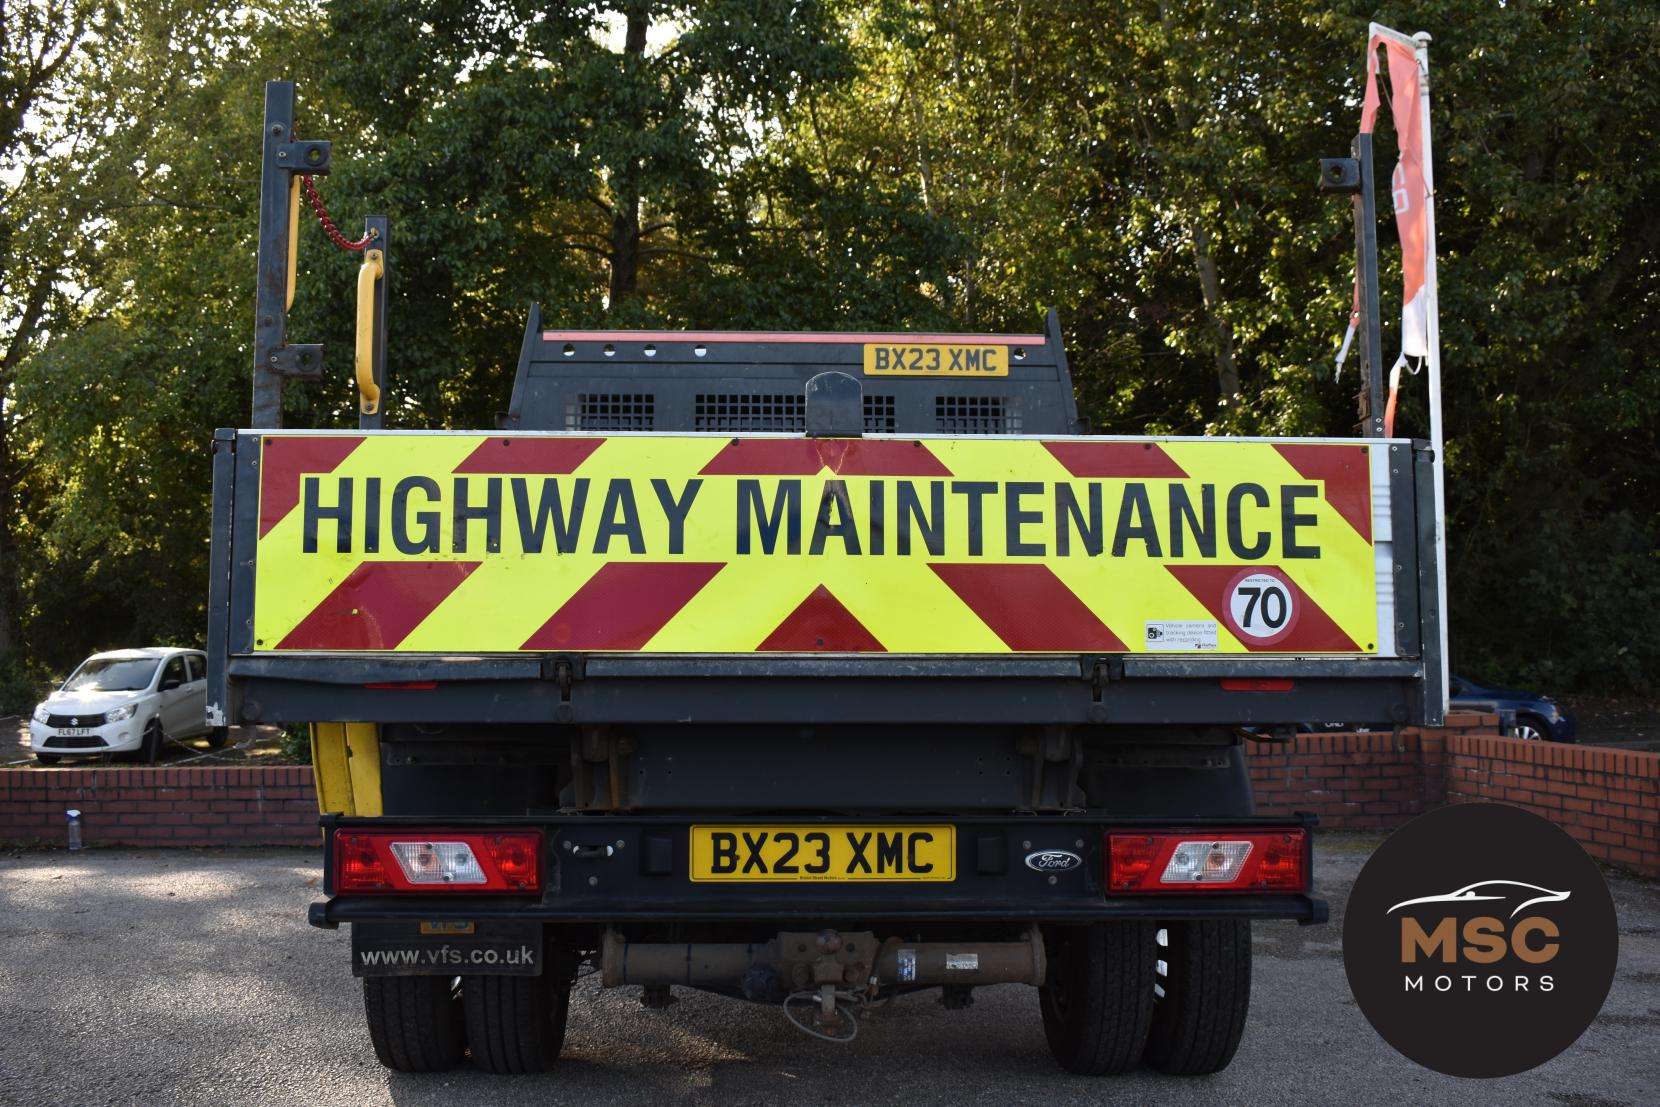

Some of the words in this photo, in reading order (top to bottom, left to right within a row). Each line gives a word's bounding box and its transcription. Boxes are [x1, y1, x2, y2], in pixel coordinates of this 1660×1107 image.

[875, 347, 940, 370] BX23
[949, 348, 997, 371] XMC
[302, 475, 704, 555] HIGHWAY
[736, 478, 1321, 560] MAINTENANCE
[1238, 586, 1287, 629] 70
[710, 832, 831, 874] BX23
[846, 832, 934, 874] XMC
[1039, 854, 1071, 868] Ford
[361, 945, 534, 966] www.vfs.co.uk
